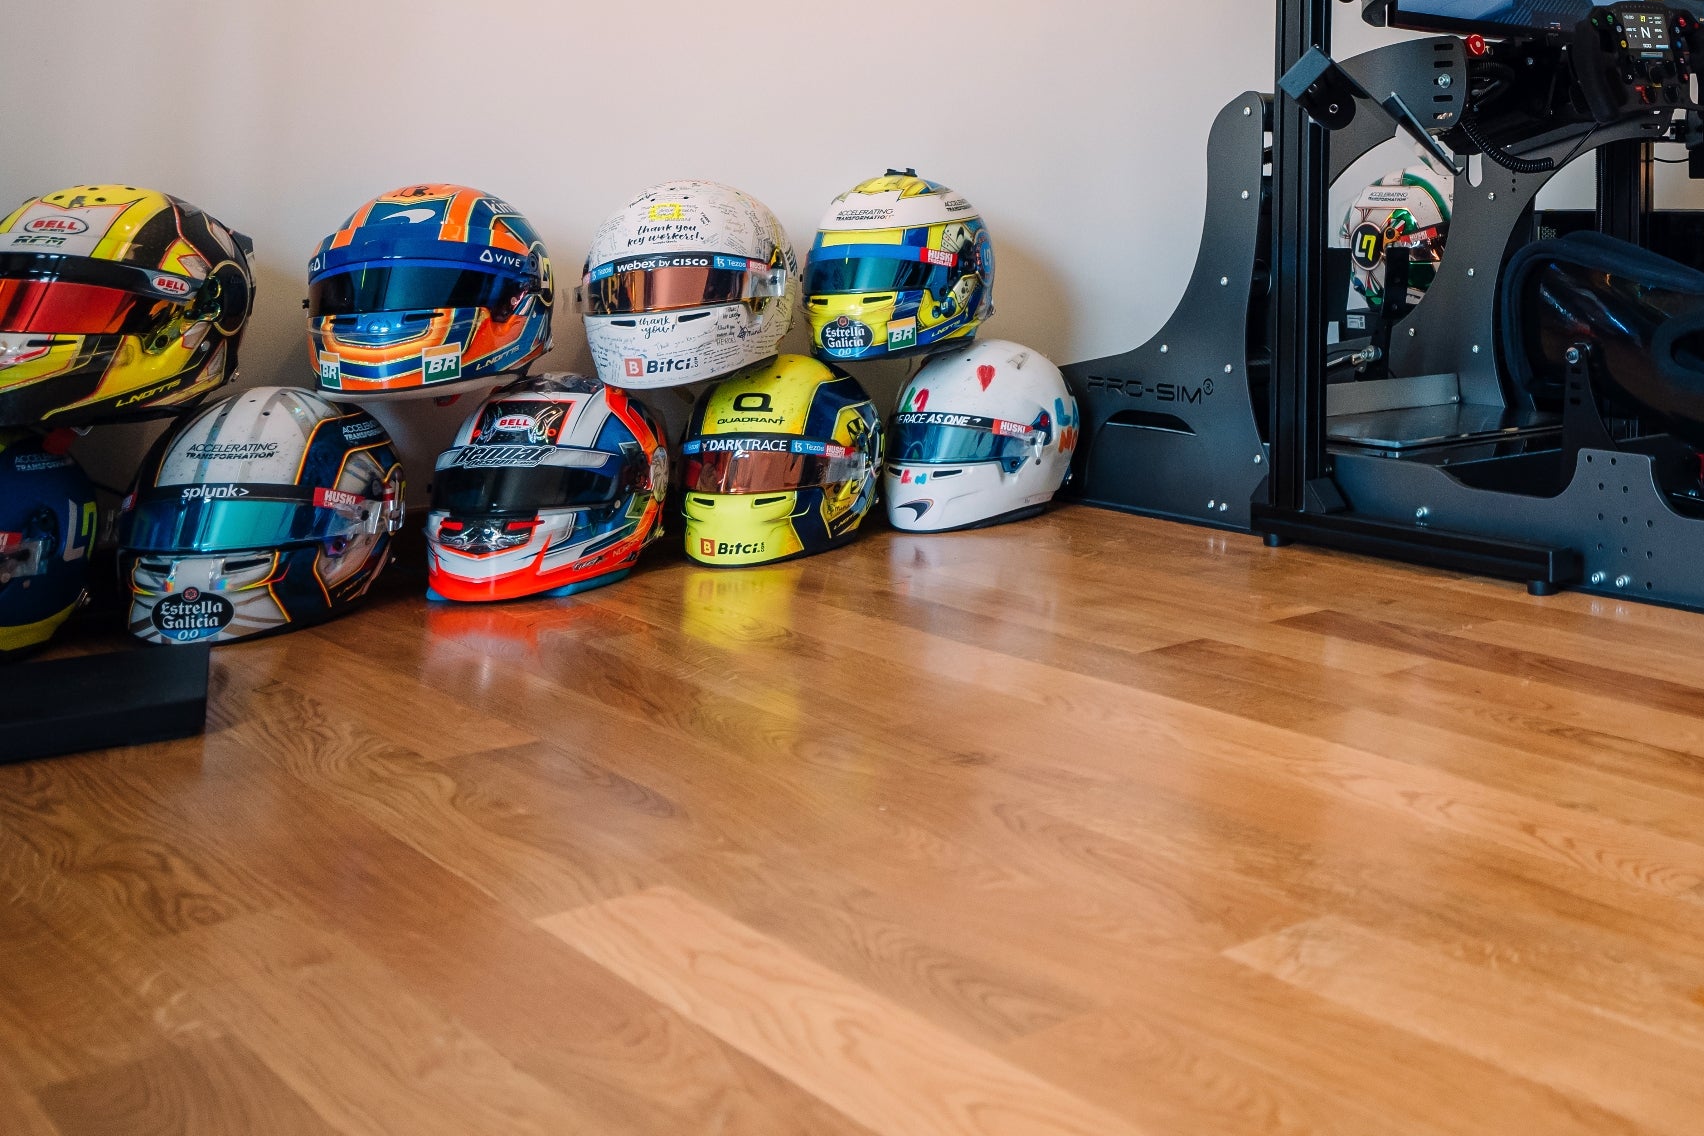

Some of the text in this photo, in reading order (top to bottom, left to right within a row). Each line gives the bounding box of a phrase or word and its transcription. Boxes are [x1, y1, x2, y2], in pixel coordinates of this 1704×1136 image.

[32, 220, 79, 230] BELL
[495, 254, 521, 268] VIVE
[927, 249, 953, 263] HUSKI
[617, 257, 656, 273] webex
[658, 257, 671, 267] by
[156, 278, 186, 292] BELL
[825, 326, 866, 338] Estrella
[891, 327, 915, 342] BR
[827, 337, 865, 349] Galicia
[428, 356, 456, 374] BR
[646, 358, 690, 374] Bitci
[322, 365, 338, 381] BR
[499, 418, 530, 426] BELL
[902, 414, 928, 424] RACE
[927, 415, 944, 424] AS
[943, 416, 970, 426] ONE
[1000, 421, 1027, 433] HUSKI
[188, 442, 279, 453] ACCELERATING
[709, 439, 788, 452] DARKTRACE
[185, 450, 276, 460] TRANSFORMATION
[324, 490, 357, 505] HUSKI
[717, 541, 758, 555] Bitci
[159, 600, 224, 615] Estrella
[161, 614, 220, 630] Galicia
